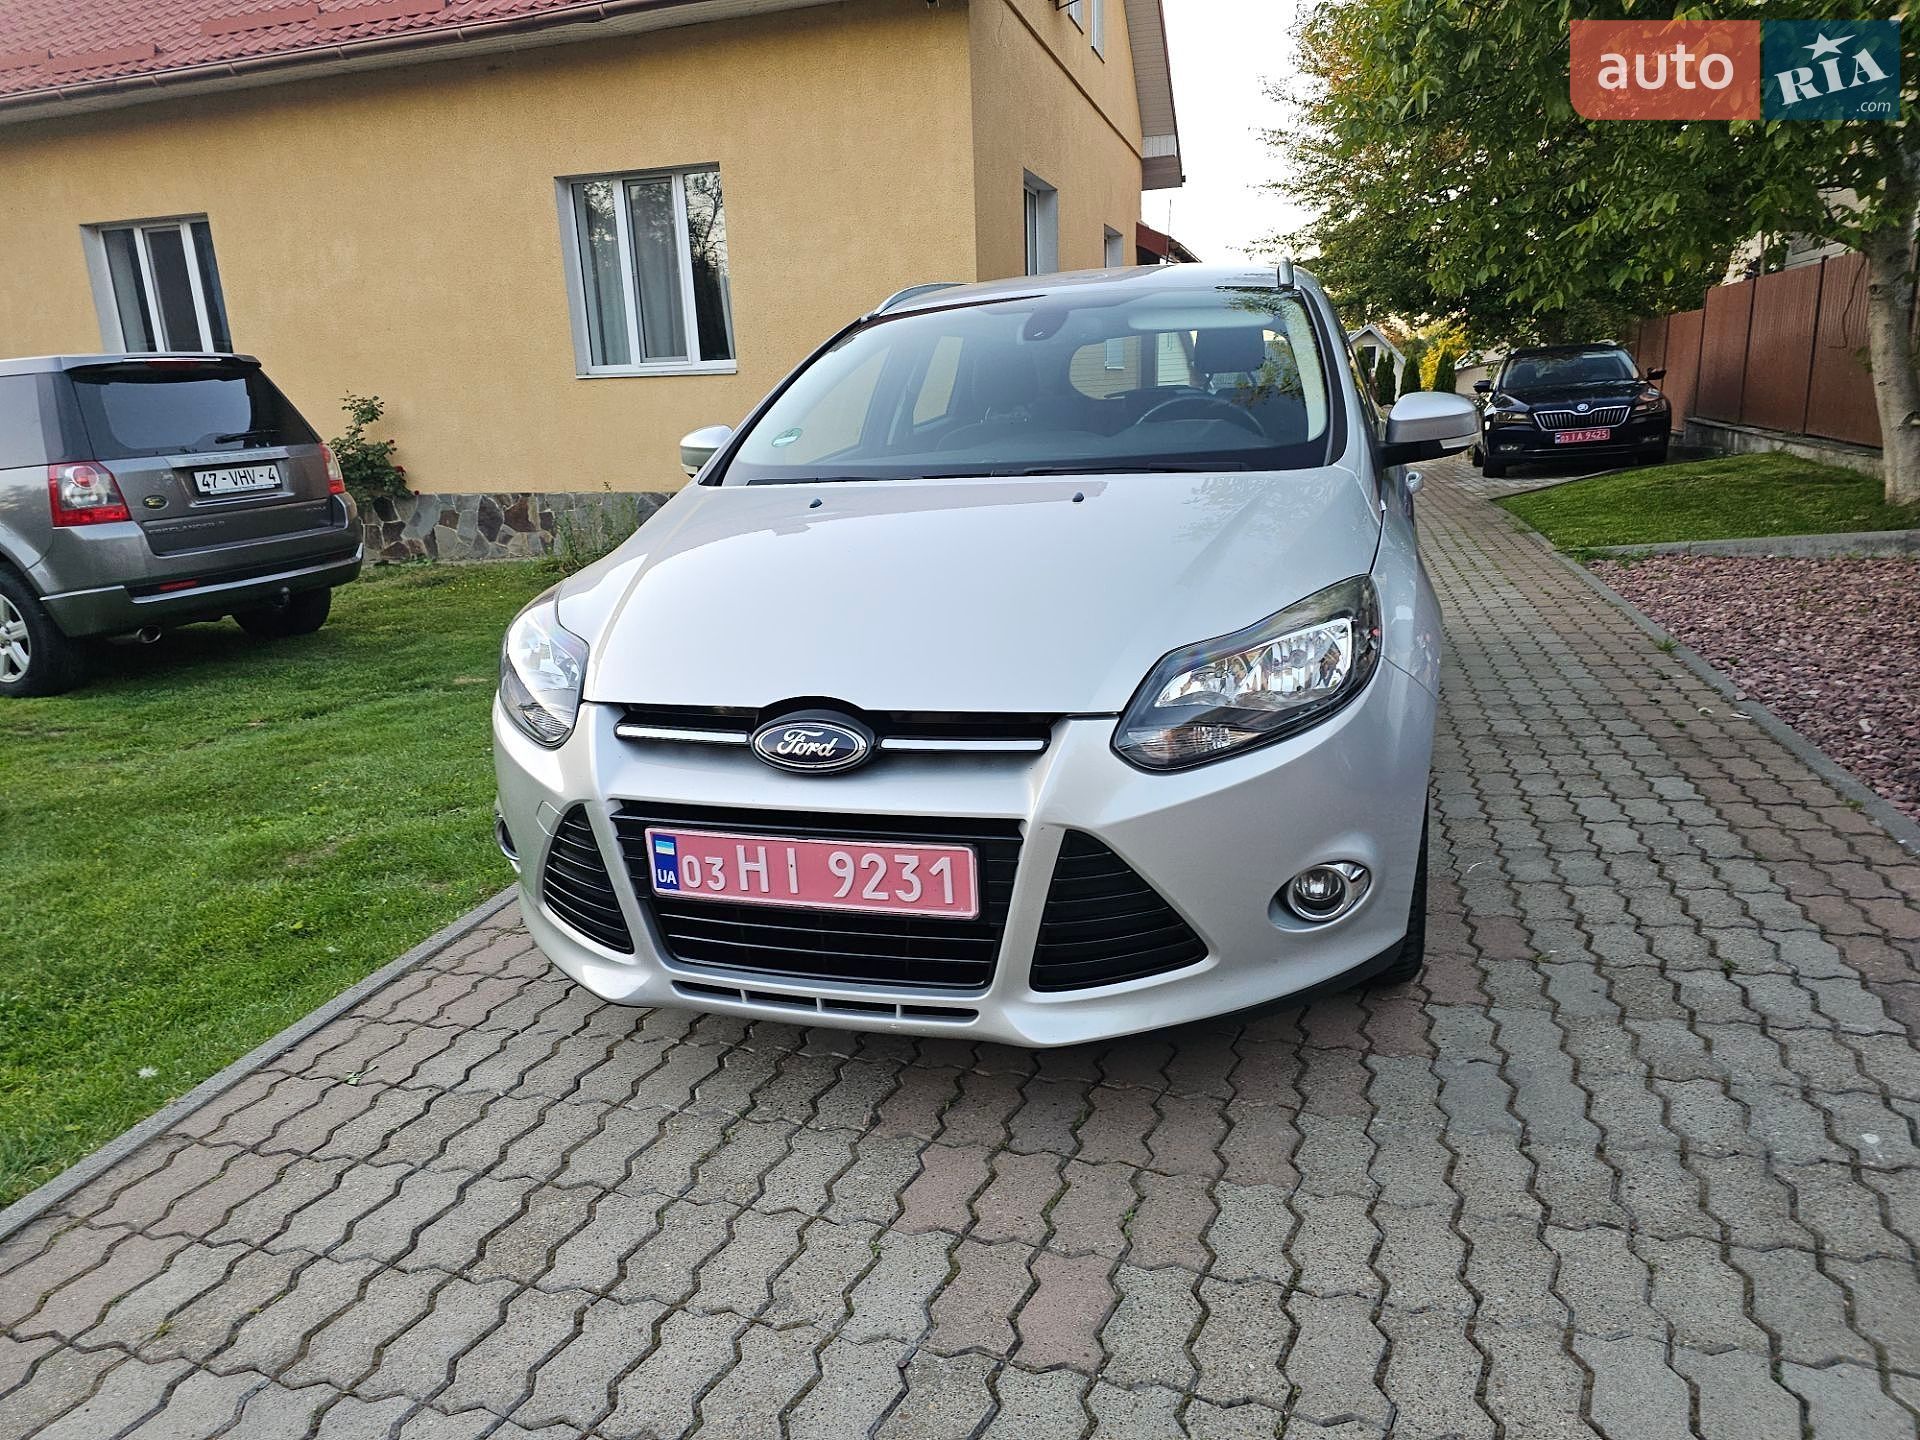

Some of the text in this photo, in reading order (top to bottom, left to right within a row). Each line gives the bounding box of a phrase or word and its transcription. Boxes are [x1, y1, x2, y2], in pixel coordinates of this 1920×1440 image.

[777, 729, 838, 757] Ford
[657, 868, 677, 886] UA
[682, 854, 727, 891] 03
[828, 850, 954, 904] 9231
